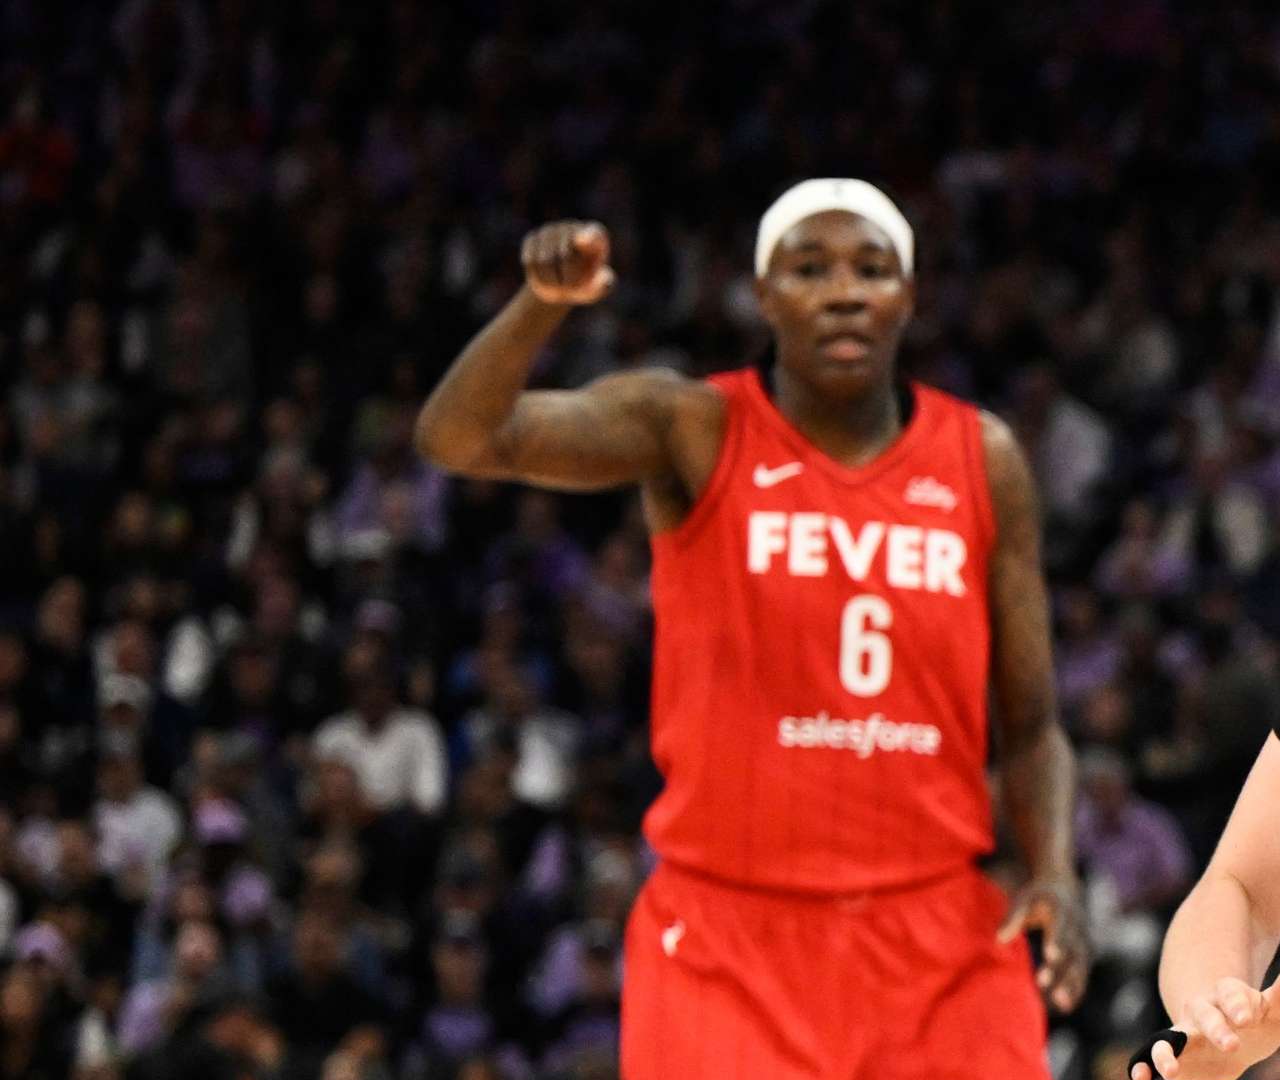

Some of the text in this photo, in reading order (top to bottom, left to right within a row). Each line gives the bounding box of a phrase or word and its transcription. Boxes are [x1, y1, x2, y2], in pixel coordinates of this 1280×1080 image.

[746, 510, 967, 598] FEVER
[838, 593, 893, 698] 6
[778, 712, 942, 759] salesforce
